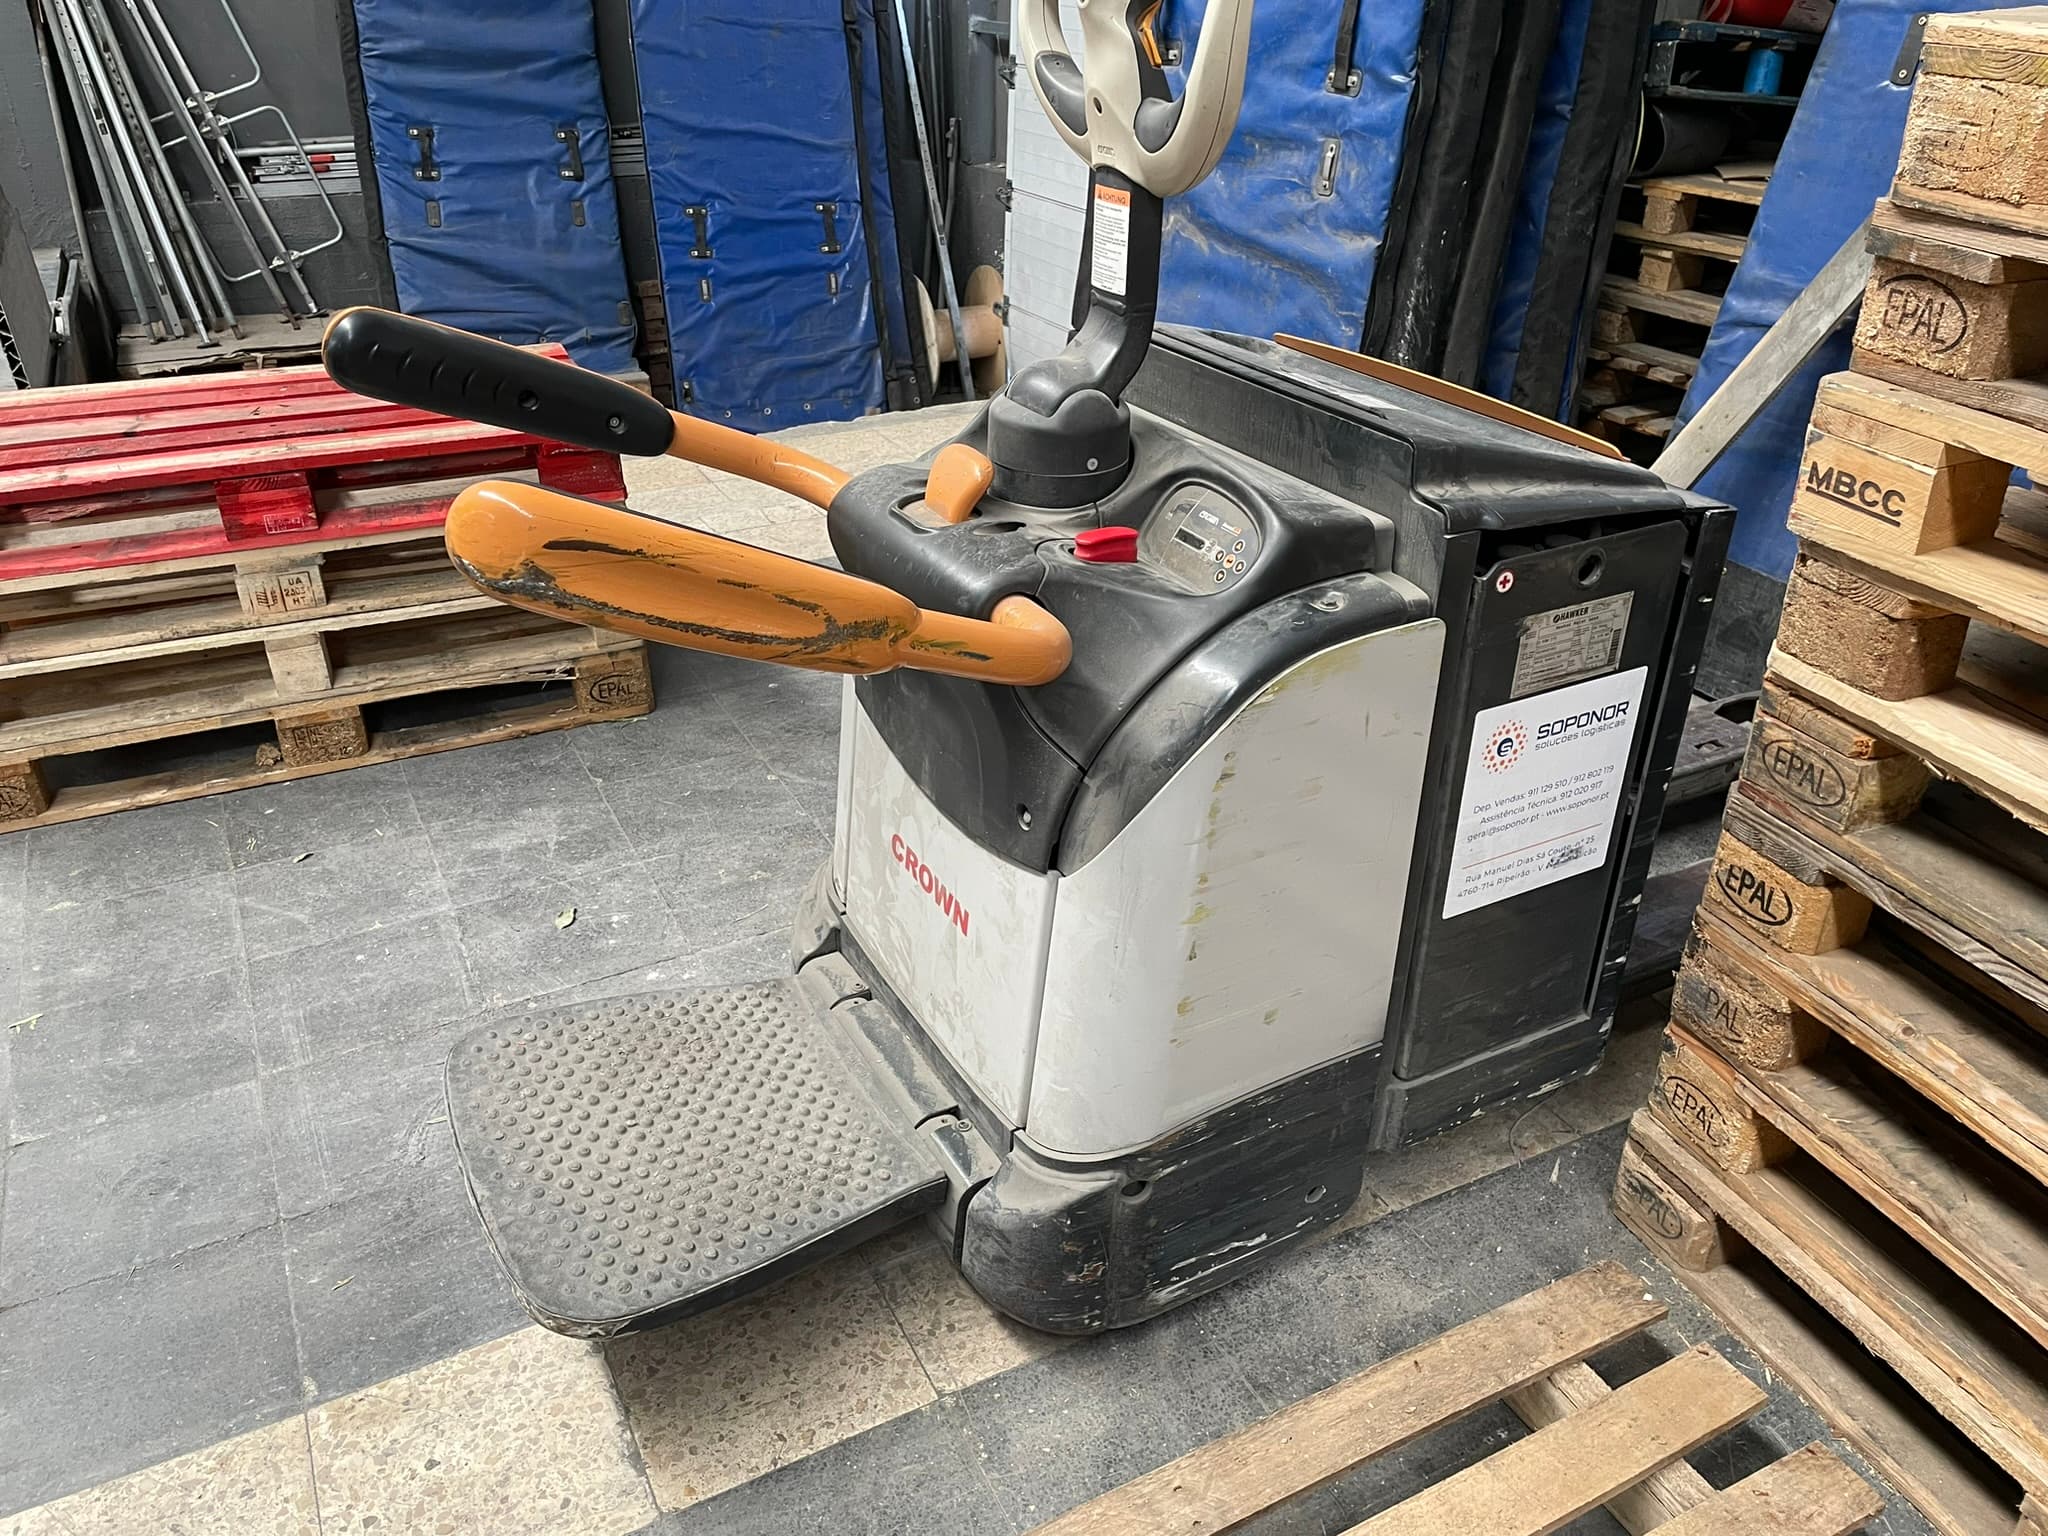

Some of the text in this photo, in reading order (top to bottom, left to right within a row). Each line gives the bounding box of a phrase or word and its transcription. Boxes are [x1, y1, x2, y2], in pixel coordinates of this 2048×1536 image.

[1882, 287, 1947, 346] EPAL
[1807, 460, 1906, 517] MBCC
[287, 577, 303, 586] UA
[1559, 606, 1590, 622] HAWKER
[598, 681, 633, 699] EPAL
[1536, 700, 1629, 740] SOPONOR
[1527, 787, 1538, 797] 911
[1540, 782, 1553, 793] 129
[1554, 778, 1567, 789] 510
[1574, 772, 1586, 783] 912
[1586, 767, 1603, 779] 802
[1603, 764, 1614, 774] 119
[1559, 789, 1572, 800] 912
[1573, 784, 1590, 796] 020
[1590, 780, 1603, 790] 917
[1773, 745, 1829, 801] EPAL
[1545, 790, 1609, 817] www.soponor.pt
[1465, 871, 1482, 884] Rua
[1483, 861, 1514, 877] Manuel
[1585, 834, 1595, 844] 25
[1496, 866, 1530, 885] Ribeirão
[892, 834, 969, 936] CROWN
[1725, 864, 1777, 921] EPAL
[1671, 1082, 1718, 1142] EPAL
